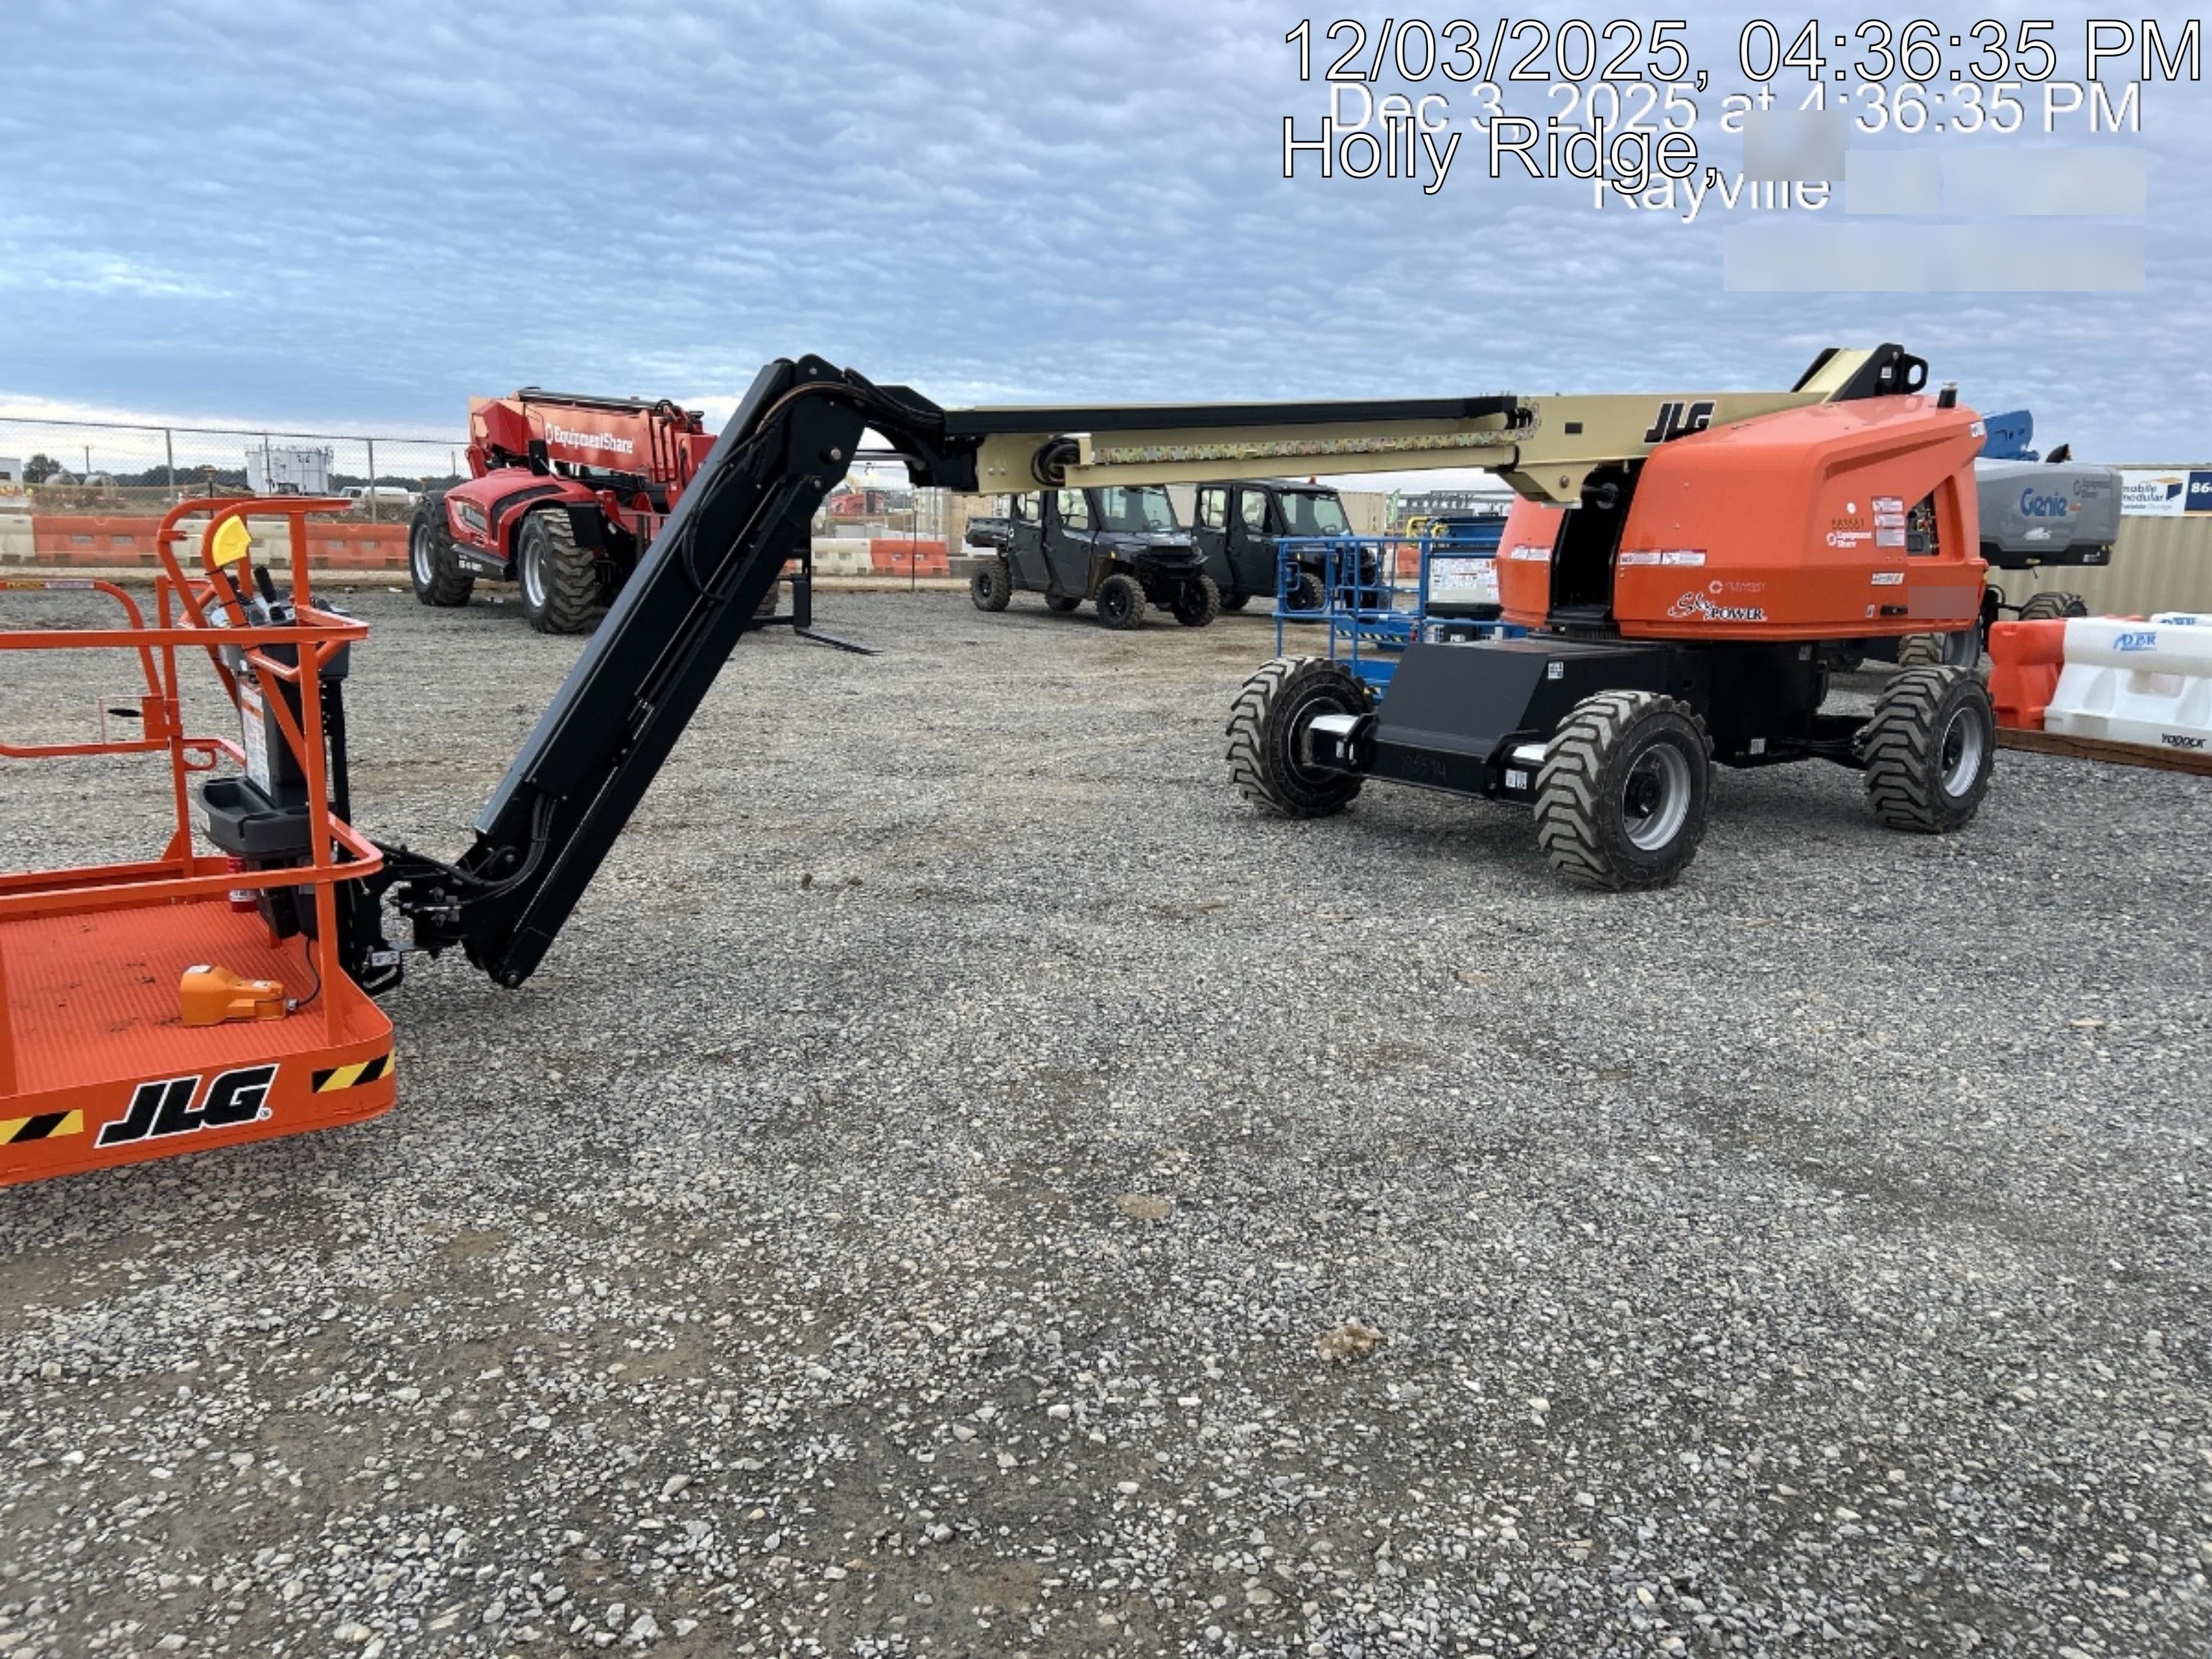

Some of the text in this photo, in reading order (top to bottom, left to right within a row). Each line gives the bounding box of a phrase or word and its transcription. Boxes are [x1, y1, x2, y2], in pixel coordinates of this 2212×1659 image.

[1643, 399, 1716, 445] JLG
[2020, 487, 2068, 517] Genie
[95, 1064, 280, 1148] JLG
